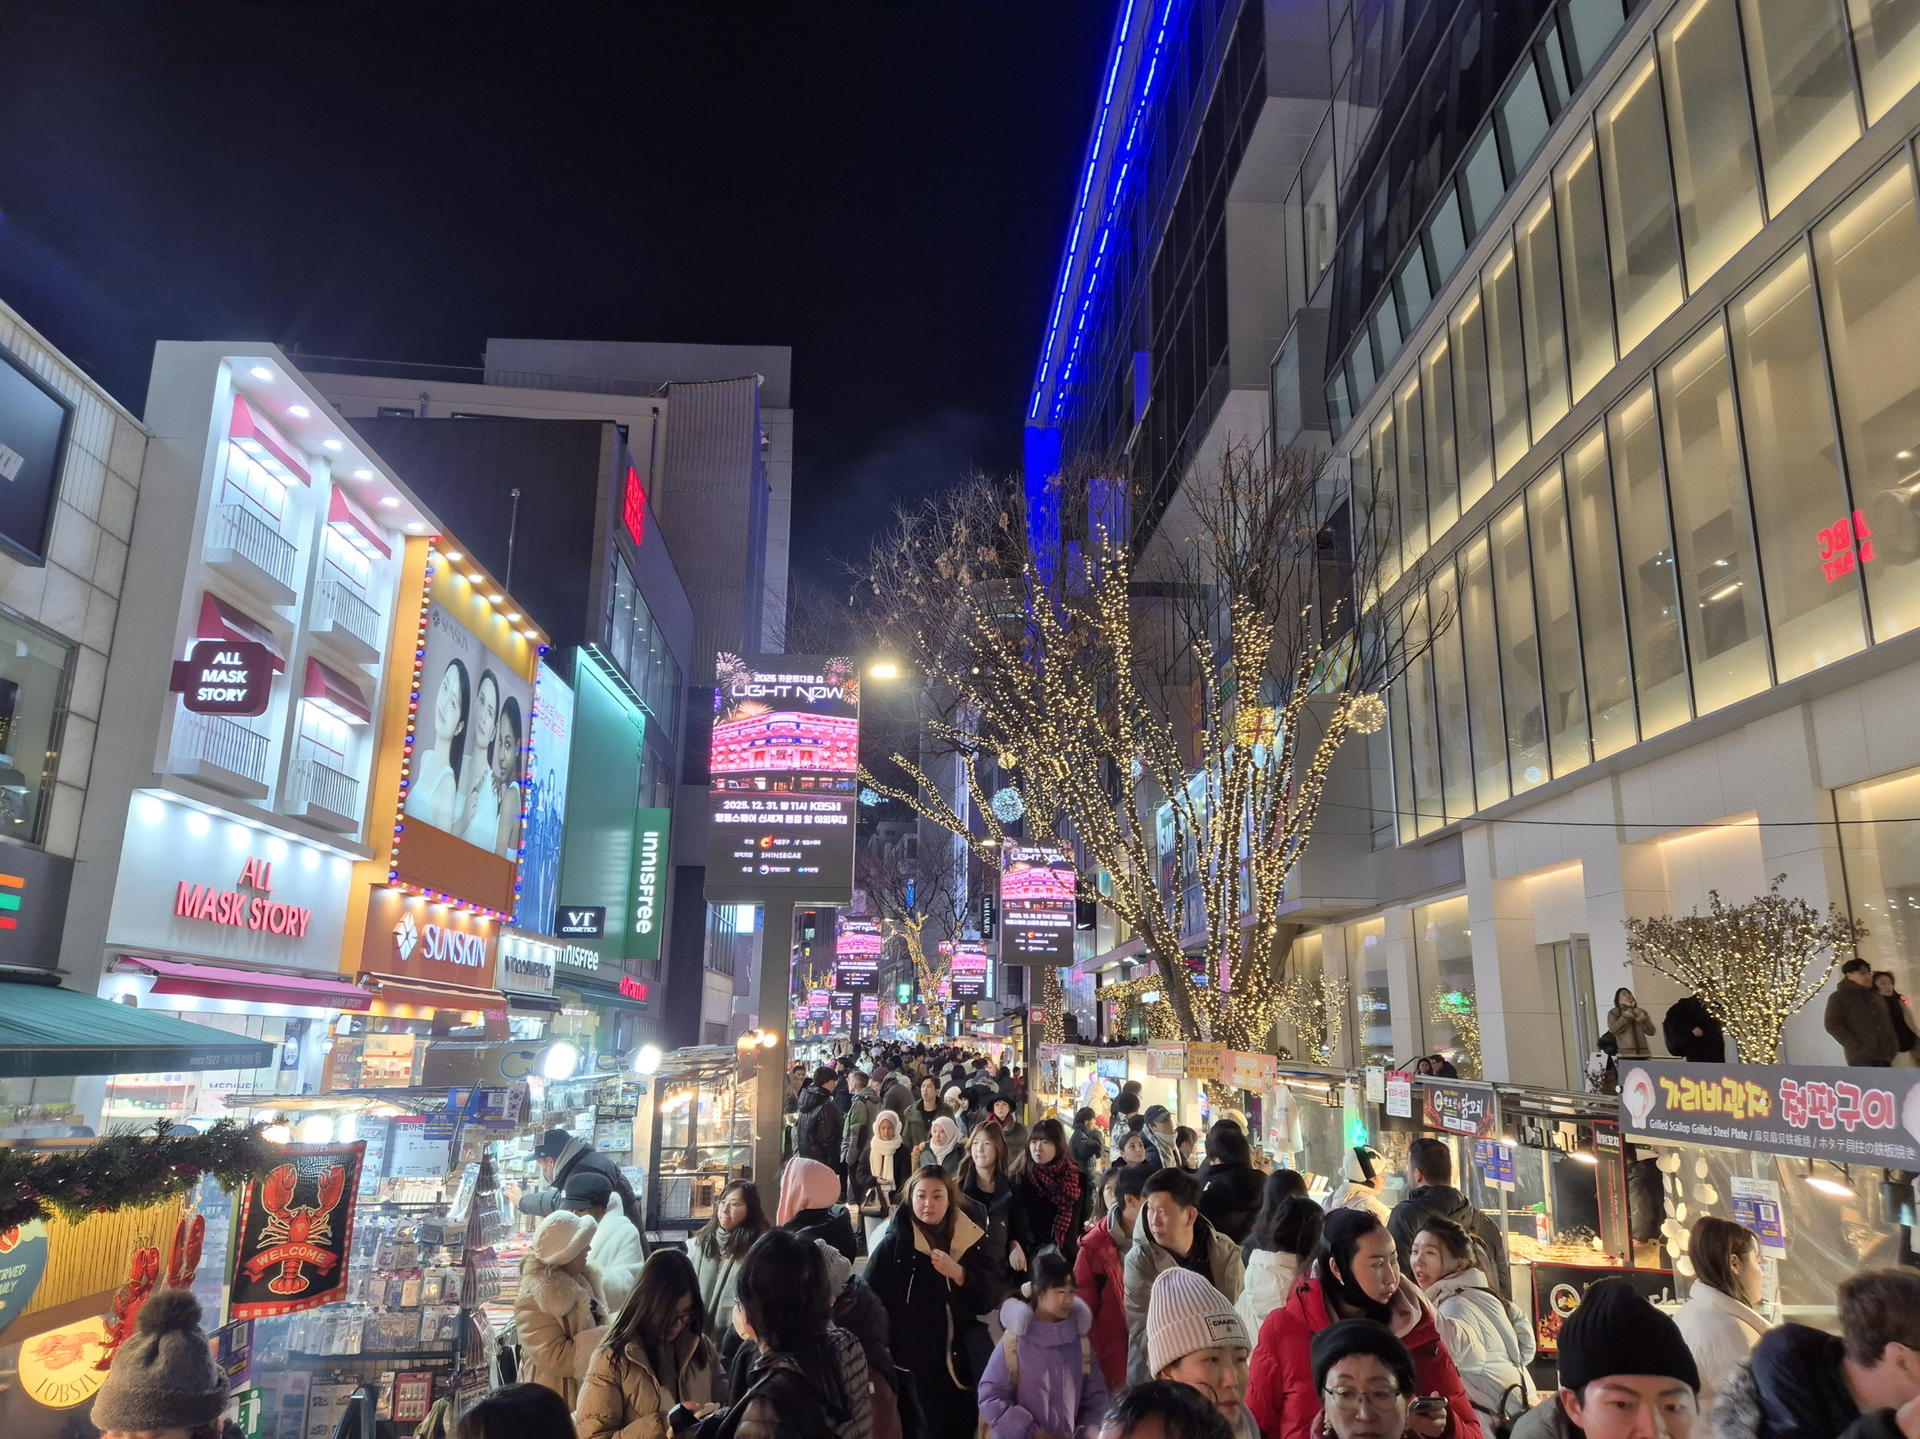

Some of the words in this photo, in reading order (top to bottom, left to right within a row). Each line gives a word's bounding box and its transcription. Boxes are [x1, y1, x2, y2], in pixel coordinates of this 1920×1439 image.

[212, 652, 243, 665] ALL
[202, 670, 248, 683] MASK
[197, 687, 247, 701] STORY
[732, 685, 792, 697] LIGHT
[236, 856, 274, 893] ALL
[175, 880, 247, 928] MASK
[248, 897, 312, 938] STORY
[568, 911, 595, 926] VT
[423, 923, 488, 969] SUNSKIN
[1780, 1078, 1895, 1132] 철판구이
[1650, 1119, 1669, 1129] Grilled
[1669, 1121, 1691, 1134] Scallop
[1691, 1124, 1713, 1136] Grilled
[1714, 1126, 1730, 1138] Steel
[1731, 1129, 1749, 1141] Plate
[256, 1246, 328, 1266] WELCOME
[1212, 1319, 1238, 1327] CHANEL
